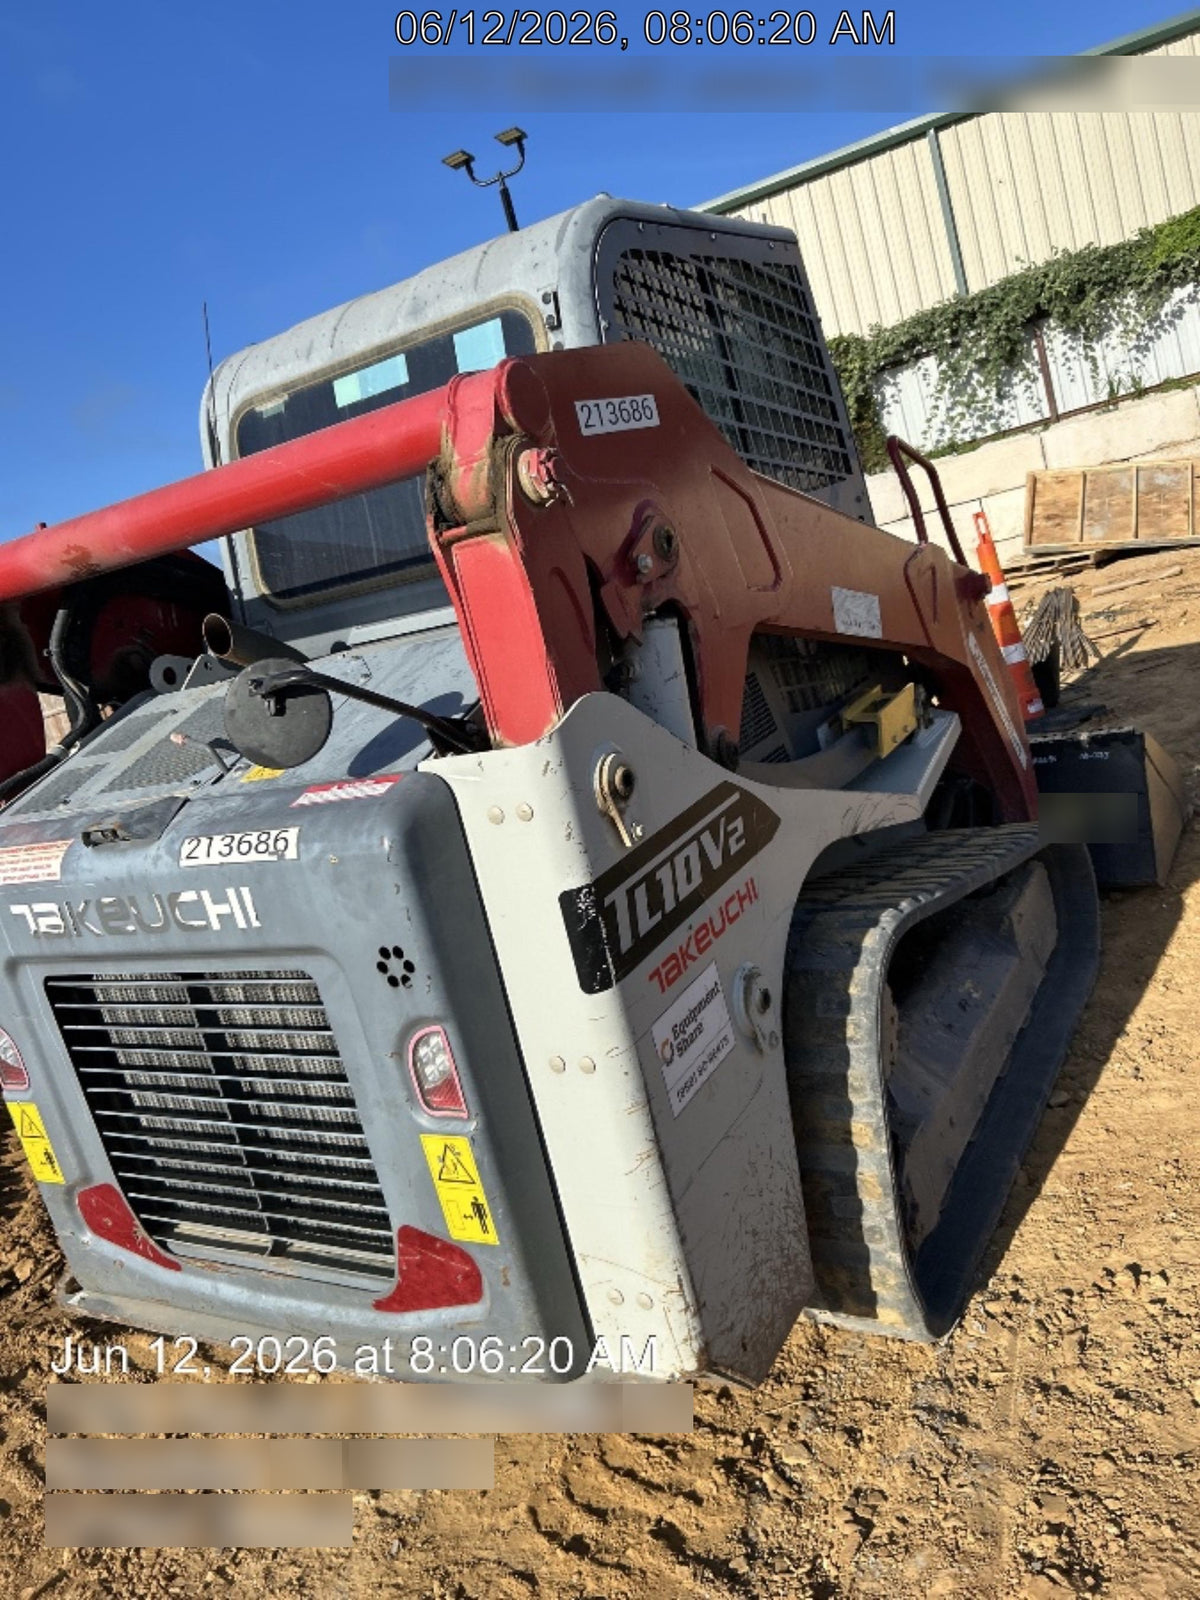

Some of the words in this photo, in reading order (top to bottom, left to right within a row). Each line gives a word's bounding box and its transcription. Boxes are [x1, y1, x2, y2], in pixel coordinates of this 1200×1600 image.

[580, 398, 654, 429] 213686
[186, 829, 290, 860] 213686
[603, 815, 747, 955] TL10V2
[672, 981, 721, 1041] Equipment
[676, 1022, 705, 1058] Share
